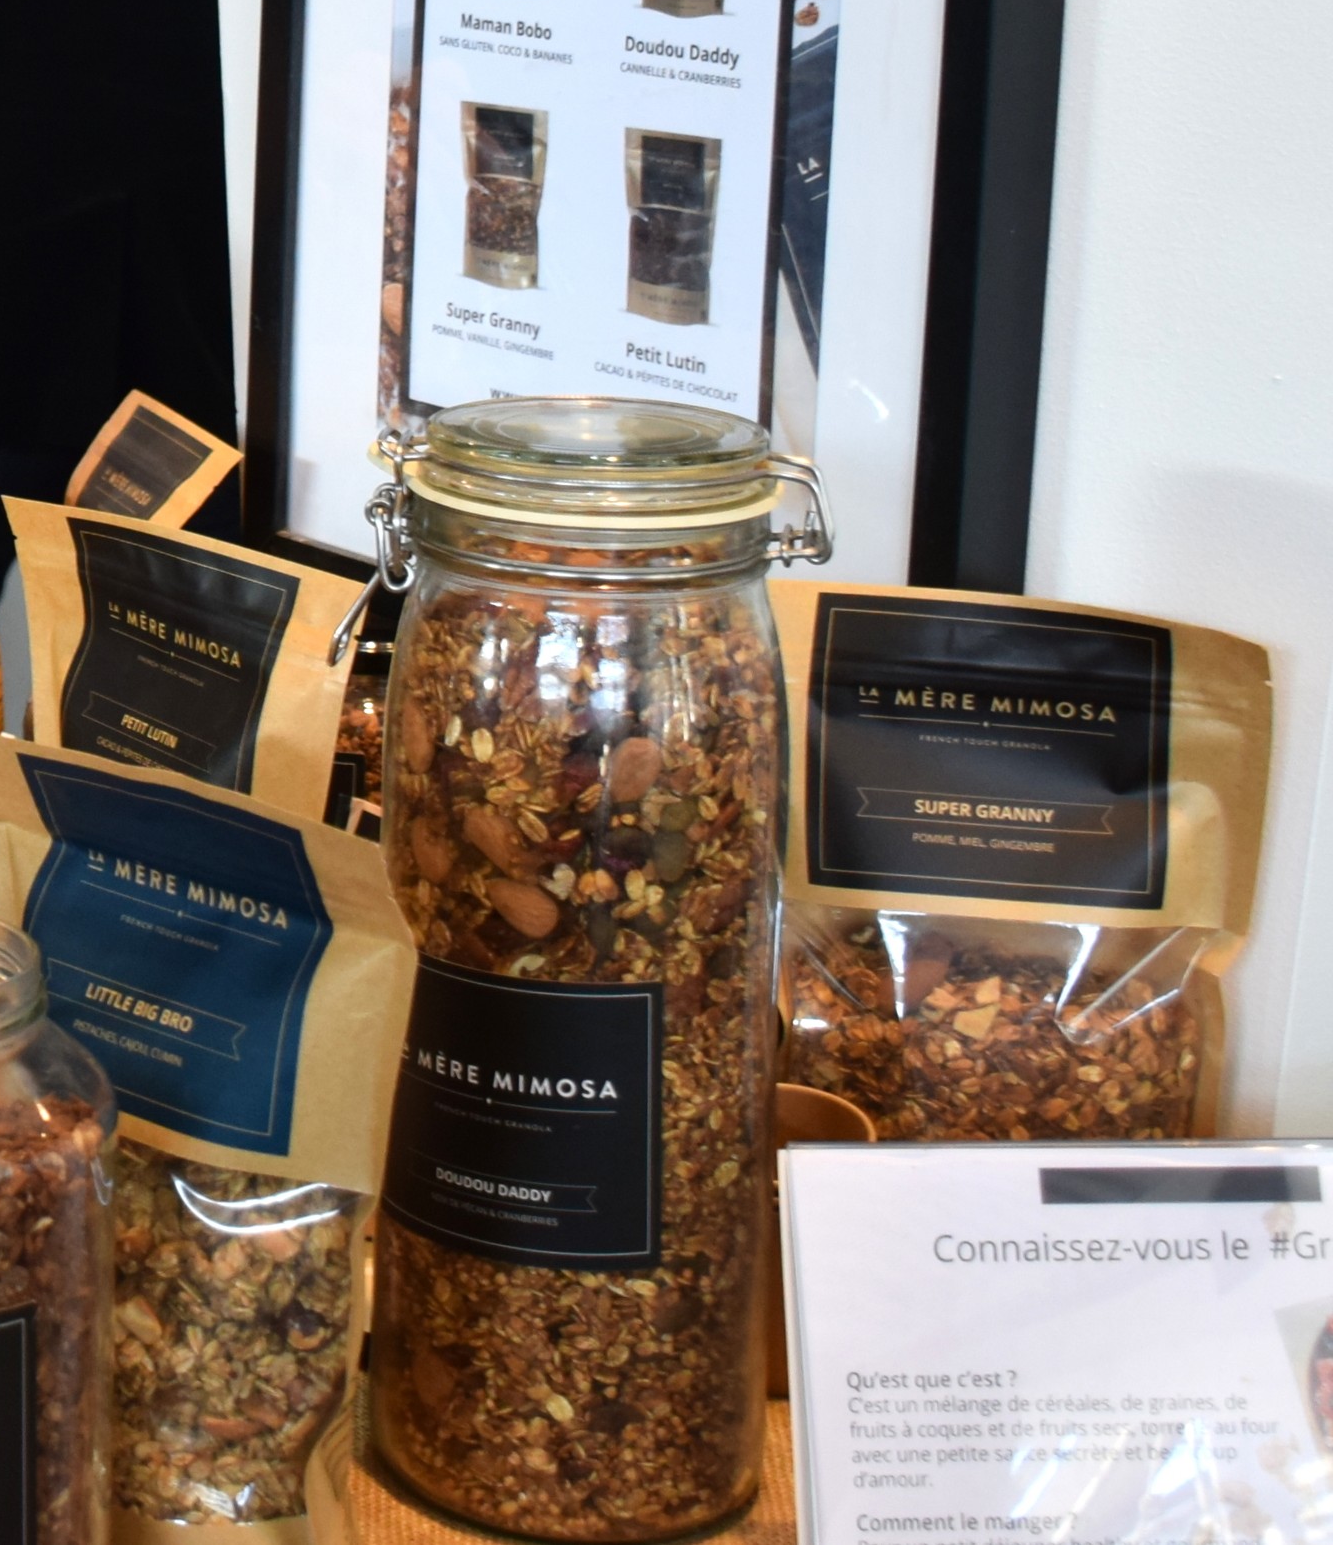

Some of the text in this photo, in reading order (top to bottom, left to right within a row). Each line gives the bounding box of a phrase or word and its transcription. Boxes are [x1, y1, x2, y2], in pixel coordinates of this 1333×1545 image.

[460, 13, 553, 40] Maman Bobo
[439, 35, 460, 48] SANS
[497, 43, 522, 59] COCO
[524, 47, 530, 59] &
[624, 35, 740, 70] Doudou Daddy
[620, 61, 742, 89] CANNELLE & CRANBERRIES
[445, 301, 541, 340] Super Granny
[504, 340, 555, 361] GINGEMBRE
[625, 341, 707, 374] Petit Lutin
[594, 360, 739, 402] CACAO & PÉPITES DE CHOCOLAT
[108, 601, 242, 669] LA MÈRE MIMOSA
[859, 684, 1118, 724] LA MÈRE MIMOSA
[121, 714, 179, 750] PETIT LUTIN
[918, 734, 1053, 751] FRENCH TOUCH GRANOLA
[914, 798, 1055, 825] SUPER GRANNY
[989, 839, 1055, 854] GINGEMBRE
[114, 857, 177, 896] MÈRE
[187, 881, 289, 930] MIMOSA
[85, 981, 193, 1034] LITTLE BIG BRO
[417, 1048, 480, 1085] MÈRE
[492, 1071, 618, 1100] MIMOSA
[434, 1166, 553, 1203] DOUDOU DADDY
[933, 1232, 1210, 1263] Connaissez-vous
[1221, 1230, 1249, 1260] le
[847, 1370, 1018, 1393] Qu'est que c'est ?
[848, 1397, 890, 1413] C'est
[895, 1401, 918, 1413] un
[923, 1394, 1002, 1416] mélange
[1007, 1395, 1030, 1412] de
[1035, 1393, 1115, 1413] céréales,
[1121, 1394, 1144, 1411] de
[1224, 1393, 1247, 1410] de
[849, 1421, 897, 1439] fruits
[902, 1420, 912, 1438] à
[917, 1423, 982, 1441] coques
[988, 1422, 1006, 1437] et
[1011, 1420, 1034, 1437] de
[1040, 1419, 1088, 1437] fruits
[1214, 1422, 1237, 1436] au
[1241, 1418, 1279, 1436] four
[851, 1448, 893, 1464] avec
[897, 1448, 932, 1463] une
[936, 1445, 990, 1466] petite
[995, 1446, 1047, 1463] sace
[1124, 1447, 1143, 1461] et
[856, 1513, 955, 1532] Comment
[960, 1512, 979, 1530] le
[985, 1514, 1062, 1535] manger
